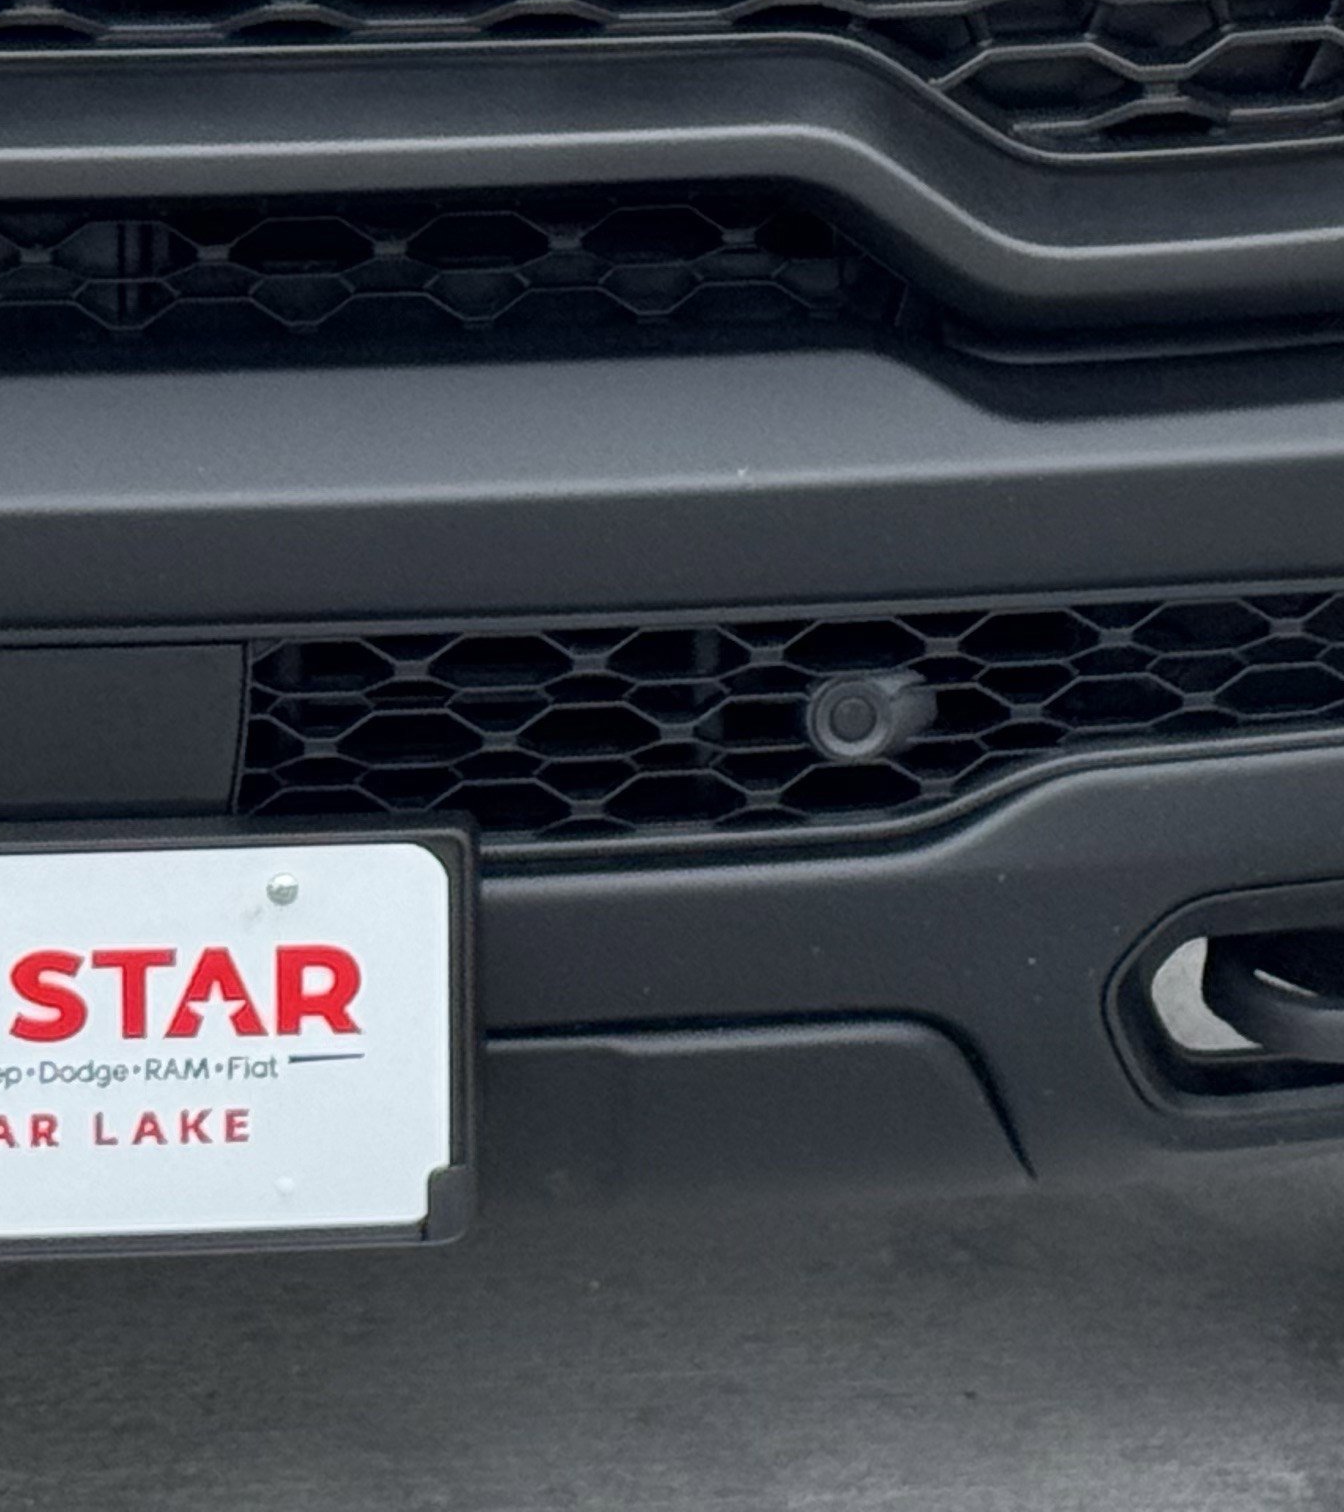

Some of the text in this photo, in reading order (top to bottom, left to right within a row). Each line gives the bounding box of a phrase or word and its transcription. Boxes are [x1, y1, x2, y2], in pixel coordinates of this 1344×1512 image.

[9, 944, 362, 1043] STAR
[38, 1059, 130, 1089] Dodge
[144, 1056, 211, 1081] RAM
[94, 1107, 252, 1146] LAKE
